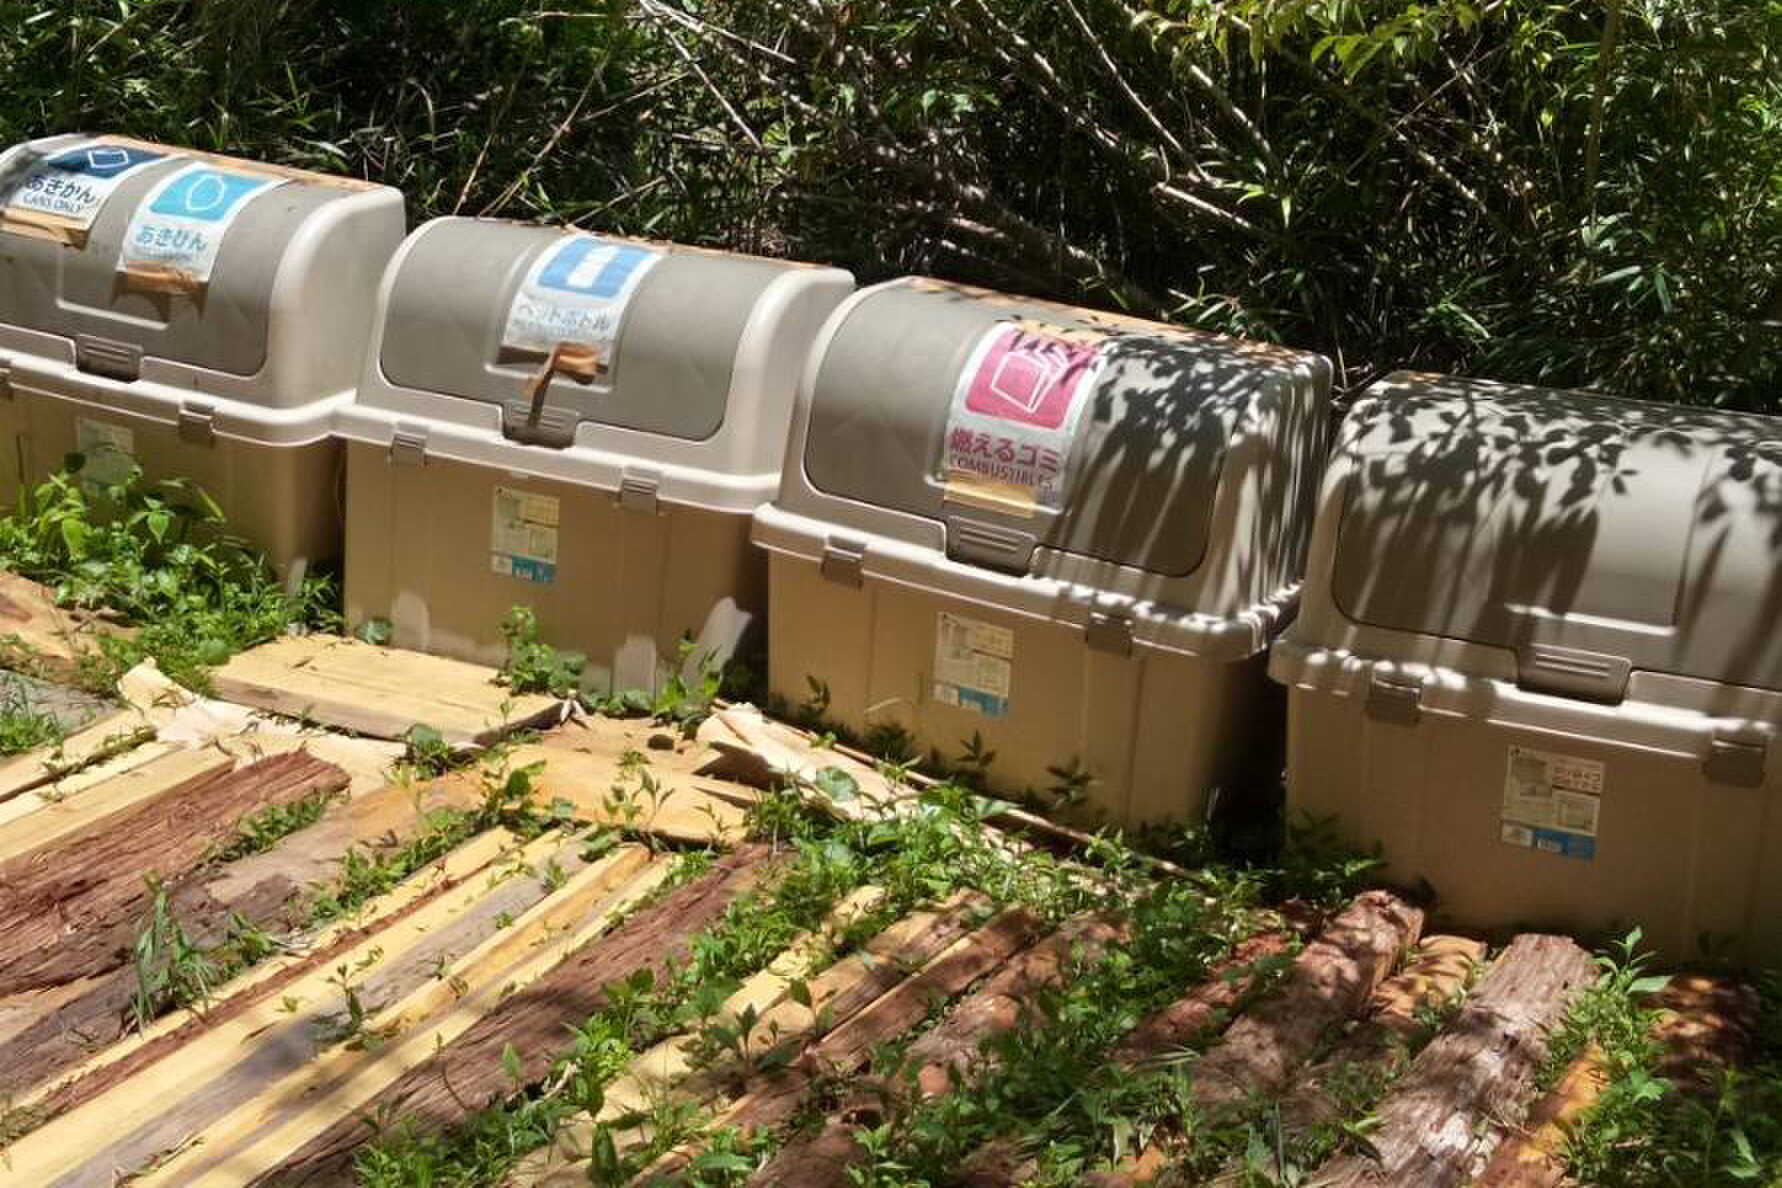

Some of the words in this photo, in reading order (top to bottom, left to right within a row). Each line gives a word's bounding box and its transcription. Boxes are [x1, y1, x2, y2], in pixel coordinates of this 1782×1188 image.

[25, 174, 96, 204] あきかん
[53, 198, 84, 213] ONLY
[136, 226, 208, 251] あきびん
[950, 427, 1059, 472] 燃えるゴミ
[949, 455, 1055, 490] COMBUSTIBLES
